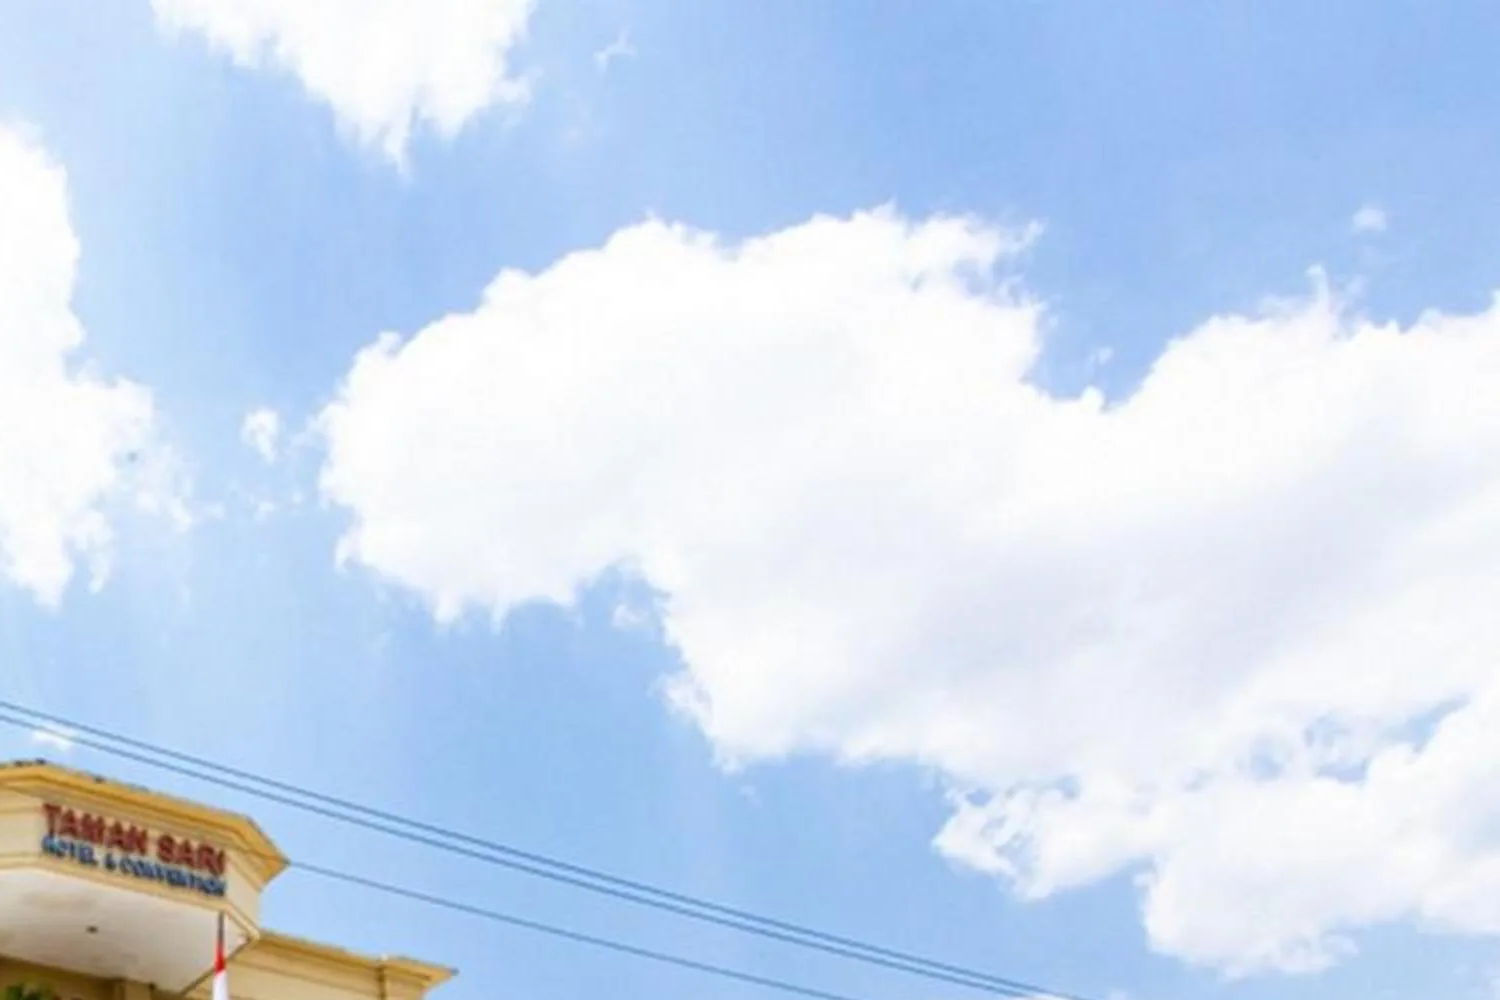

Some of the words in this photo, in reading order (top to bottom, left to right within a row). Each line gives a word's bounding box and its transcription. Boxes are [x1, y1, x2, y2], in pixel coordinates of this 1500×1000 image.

[41, 834, 98, 866] HOTEL
[42, 803, 149, 855] TAMAN
[157, 833, 226, 877] SARI
